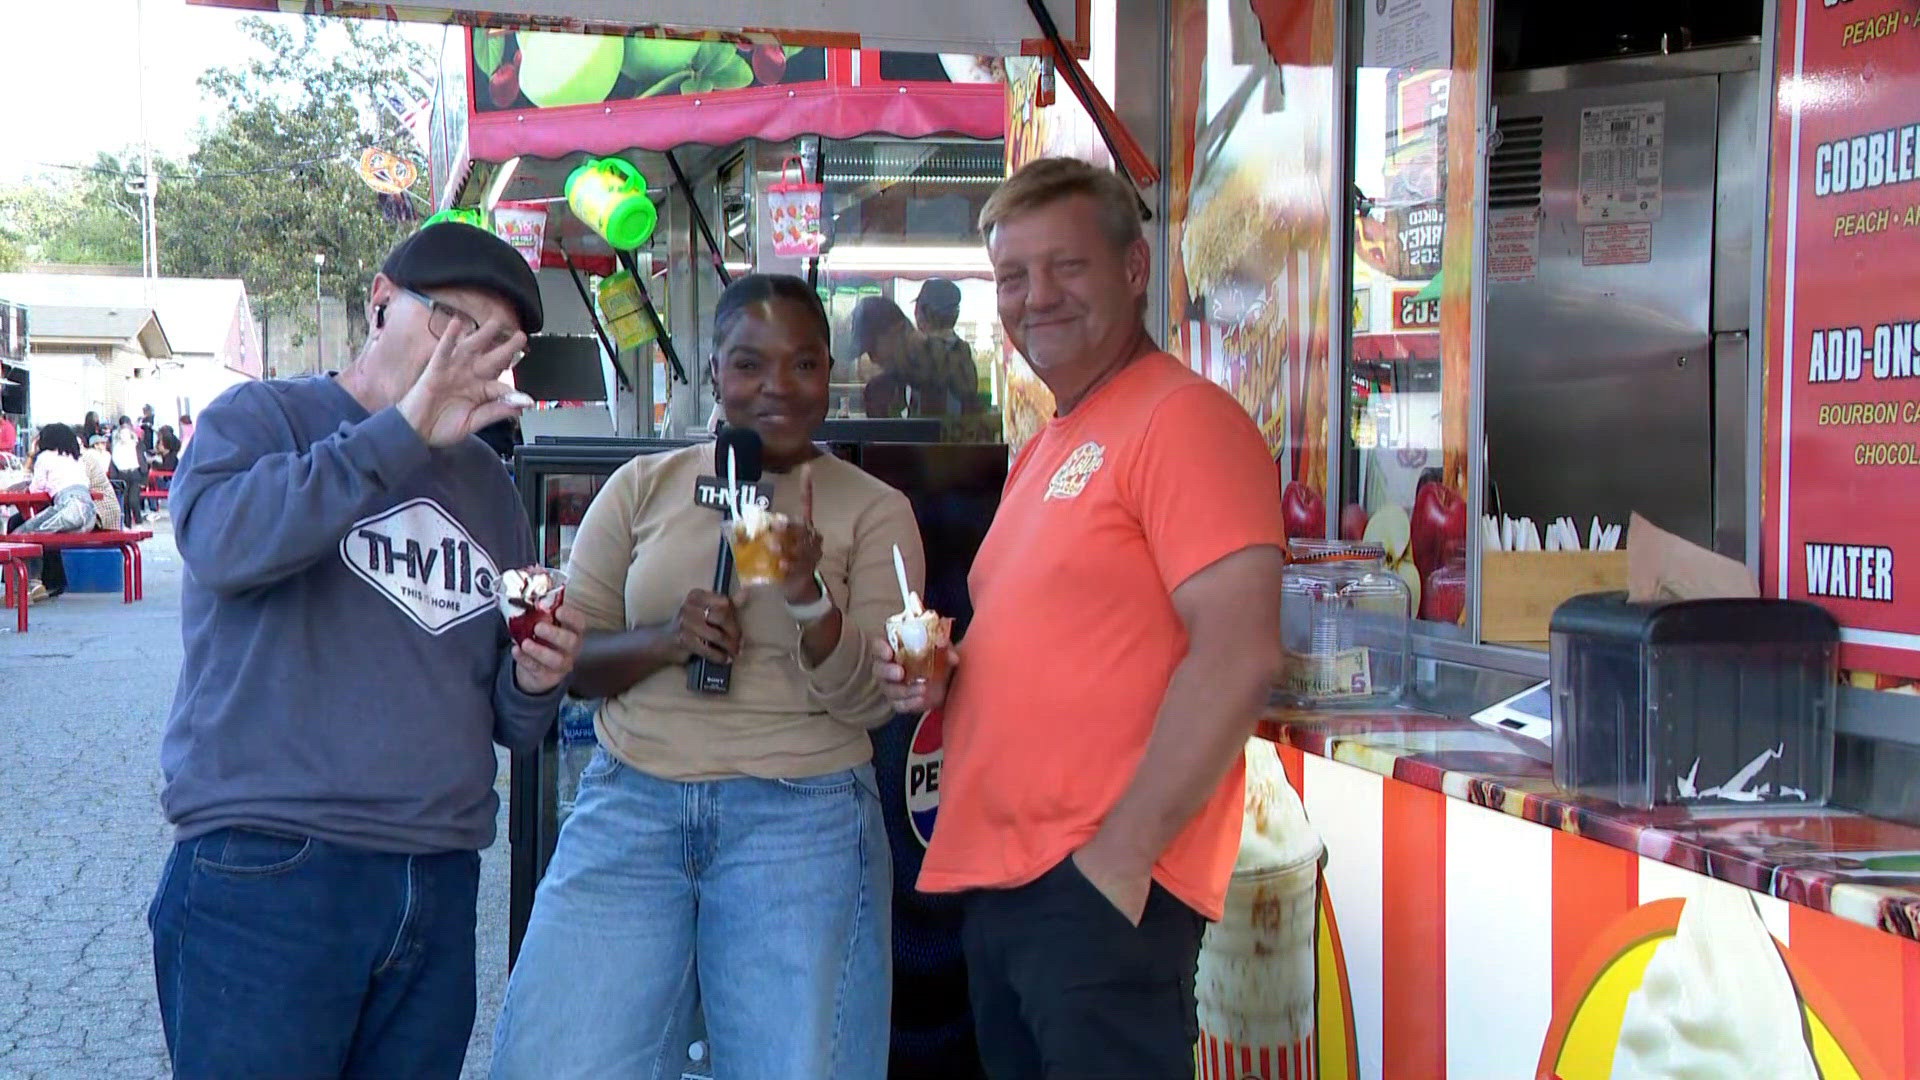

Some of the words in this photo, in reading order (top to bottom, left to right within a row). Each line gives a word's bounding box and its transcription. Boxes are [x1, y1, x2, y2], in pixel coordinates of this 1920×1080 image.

[1842, 11, 1899, 47] PEACH
[1834, 209, 1890, 238] PEACH
[1819, 402, 1899, 425] BOURBON
[1855, 444, 1920, 465] CHOCOL
[1805, 544, 1893, 601] WATER
[401, 586, 422, 601] THIS
[431, 597, 461, 612] HOME
[1352, 672, 1366, 693] 5
[911, 759, 943, 796] PE
